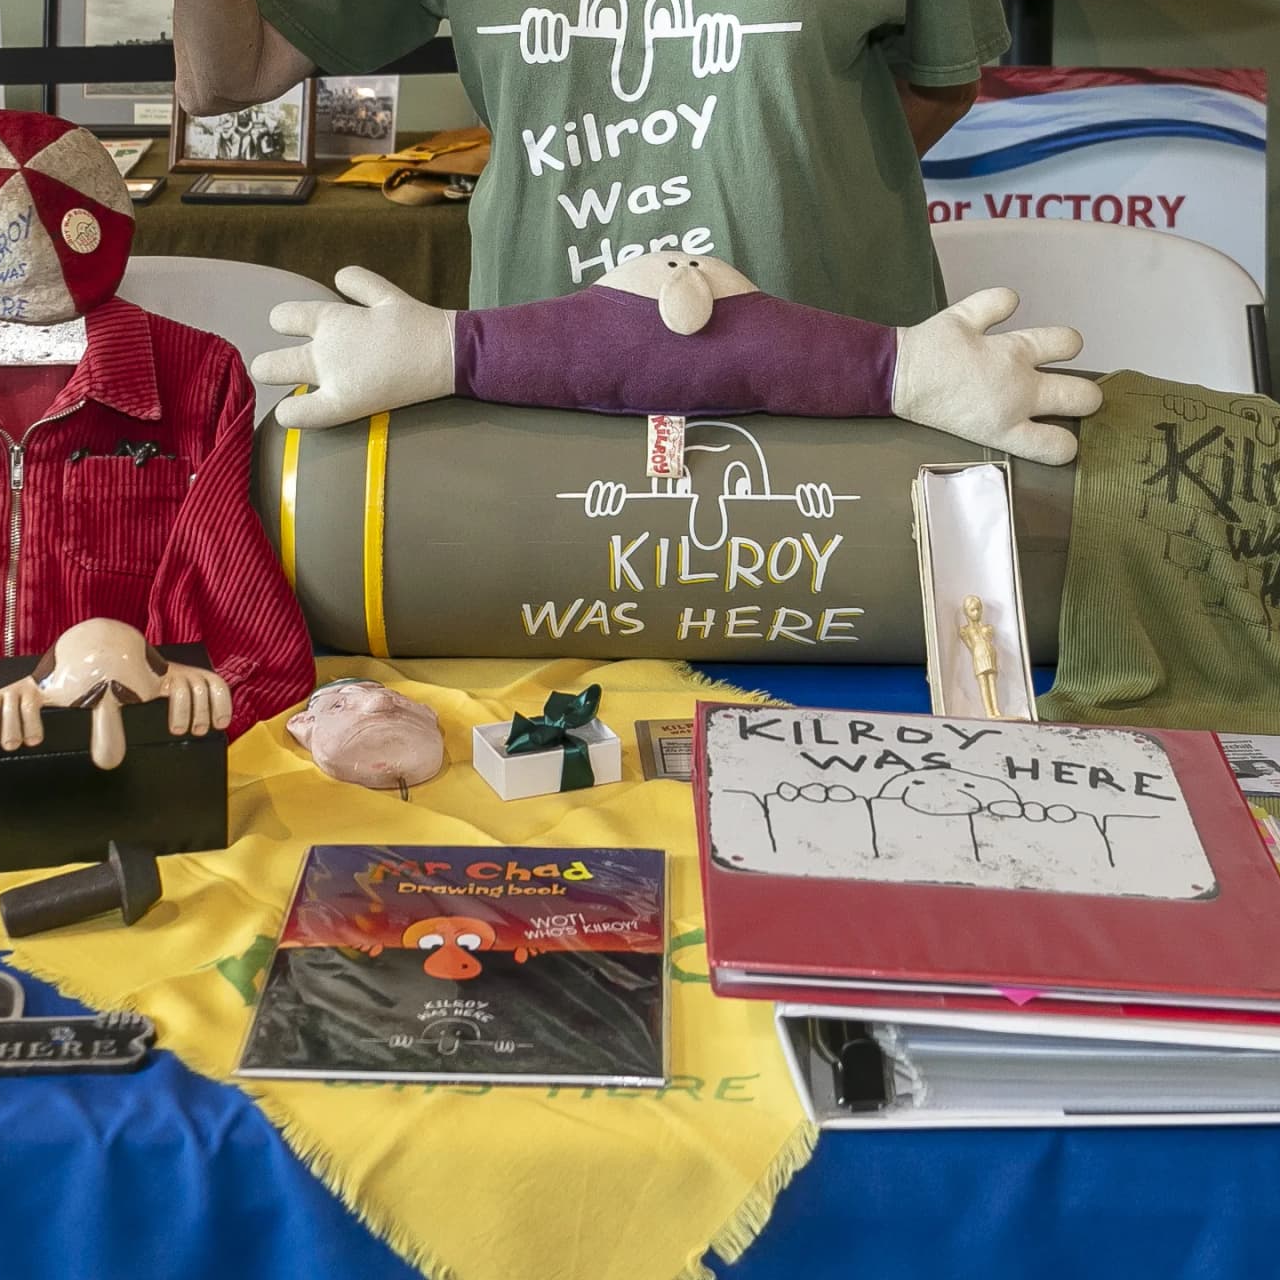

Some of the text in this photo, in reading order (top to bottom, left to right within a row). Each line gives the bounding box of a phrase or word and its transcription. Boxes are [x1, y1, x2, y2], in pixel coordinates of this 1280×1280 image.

[557, 175, 691, 229] Was
[984, 194, 1185, 228] VICTORY
[609, 532, 843, 593] KILROY
[521, 599, 864, 644] WAS HERE
[738, 715, 1001, 749] KILROY
[801, 750, 1177, 801] WAS HERE
[398, 882, 567, 898] Drawing book
[466, 861, 595, 881] Chad
